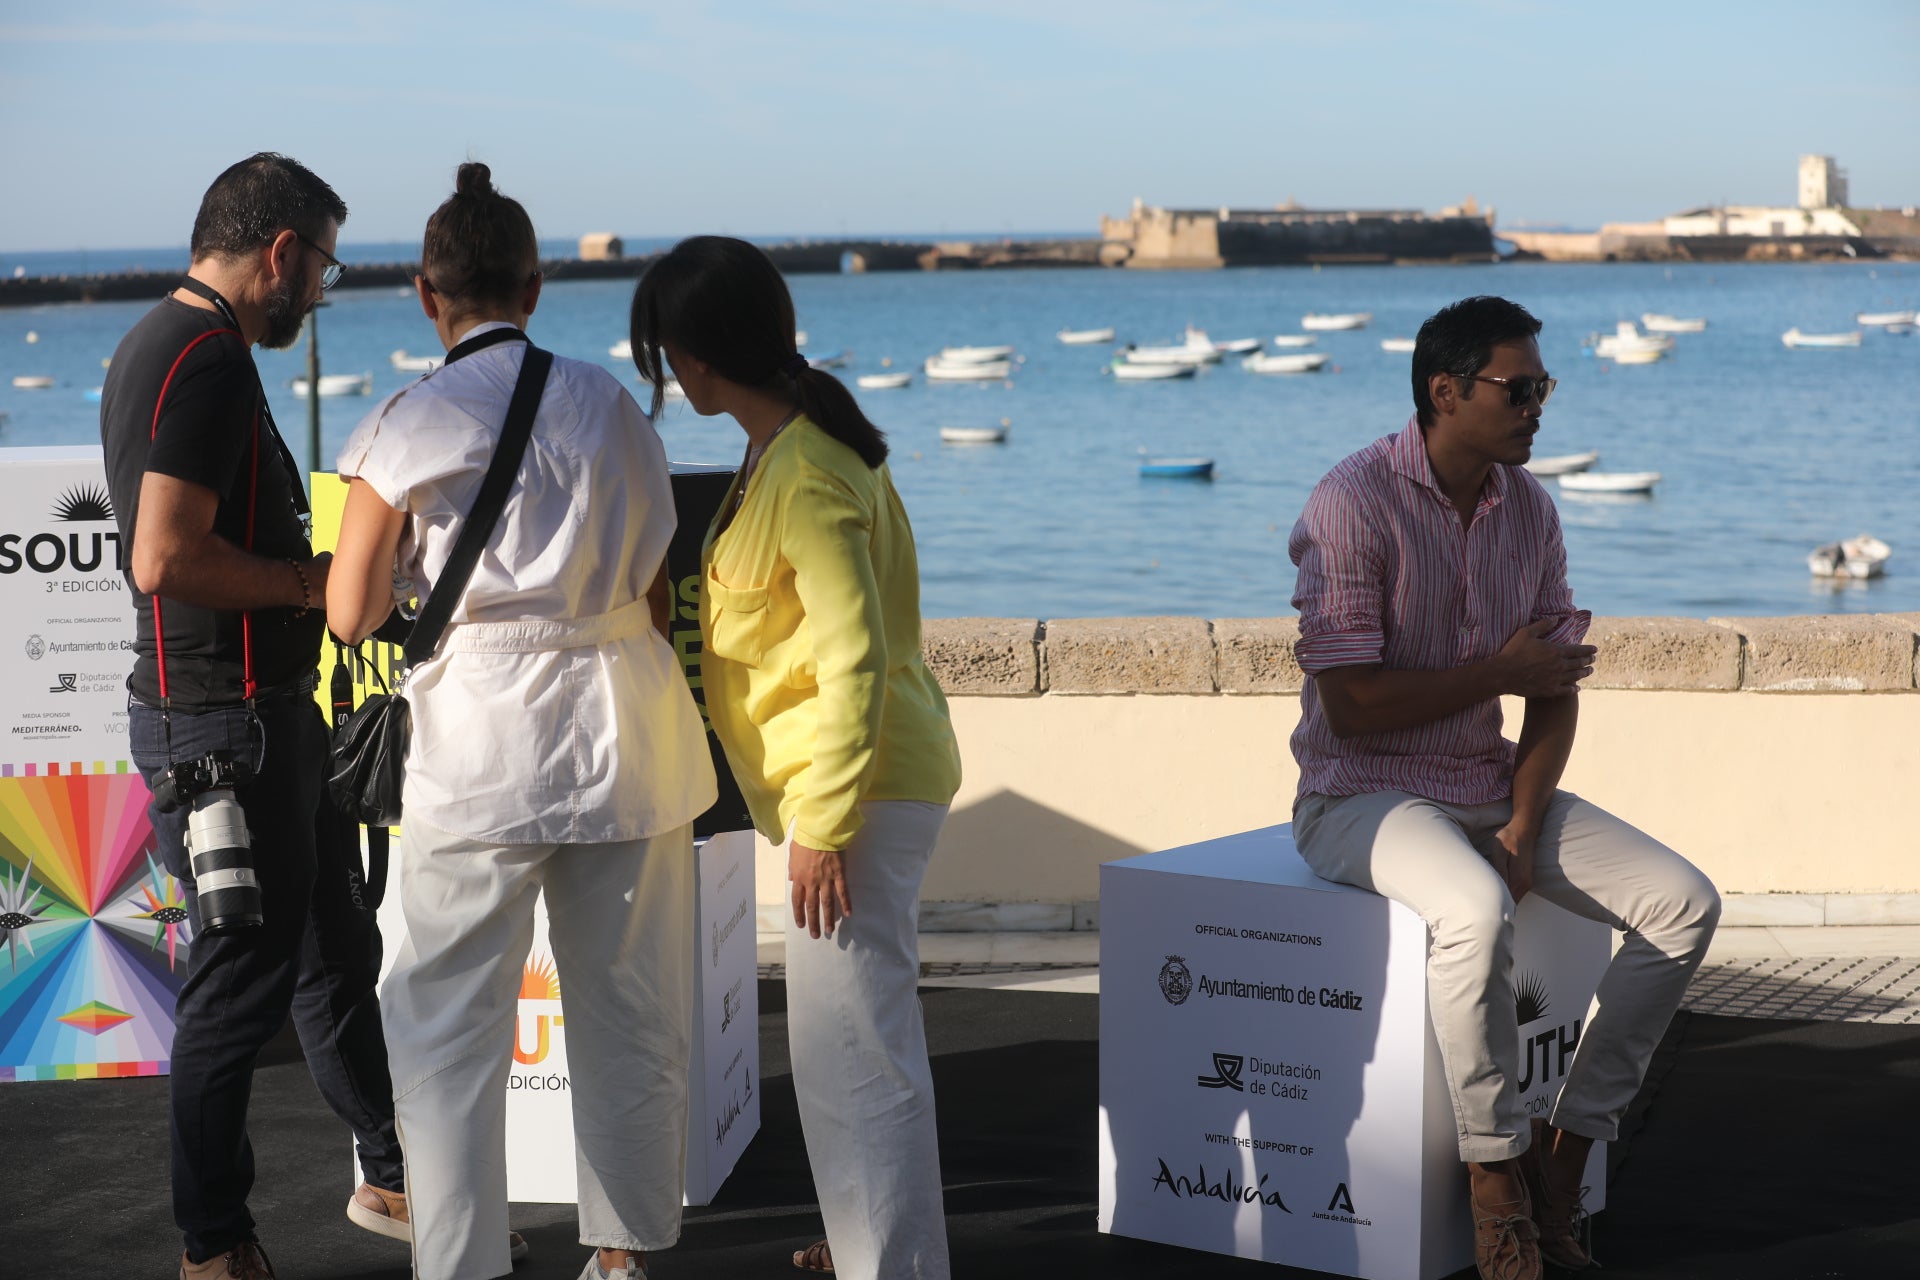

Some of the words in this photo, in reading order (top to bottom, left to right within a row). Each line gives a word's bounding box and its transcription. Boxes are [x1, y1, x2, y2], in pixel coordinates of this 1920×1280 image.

[62, 578, 121, 592] EDICIÓN
[49, 641, 106, 654] Ayuntamiento
[107, 640, 118, 651] de
[80, 672, 122, 682] Diputación
[80, 684, 90, 692] de
[93, 683, 115, 692] Cádiz
[1195, 924, 1238, 938] OFFICIAL
[1240, 929, 1322, 946] ORGANIZATIONS
[1198, 974, 1294, 1003] Ayuntamiento
[1297, 986, 1315, 1006] de
[1319, 987, 1363, 1011] Cádiz
[1250, 1057, 1321, 1081] Diputación
[506, 1073, 572, 1091] DICIÓN
[1250, 1081, 1266, 1095] de
[1271, 1082, 1308, 1101] Cádiz
[1205, 1133, 1230, 1145] WITH
[1232, 1136, 1251, 1148] THE
[1253, 1139, 1297, 1155] SUPPORT
[1299, 1146, 1314, 1157] OF
[1151, 1156, 1293, 1214] Andalucía
[1311, 1211, 1330, 1221] Junta
[1330, 1213, 1340, 1222] de
[1340, 1215, 1372, 1227] Andalucía
